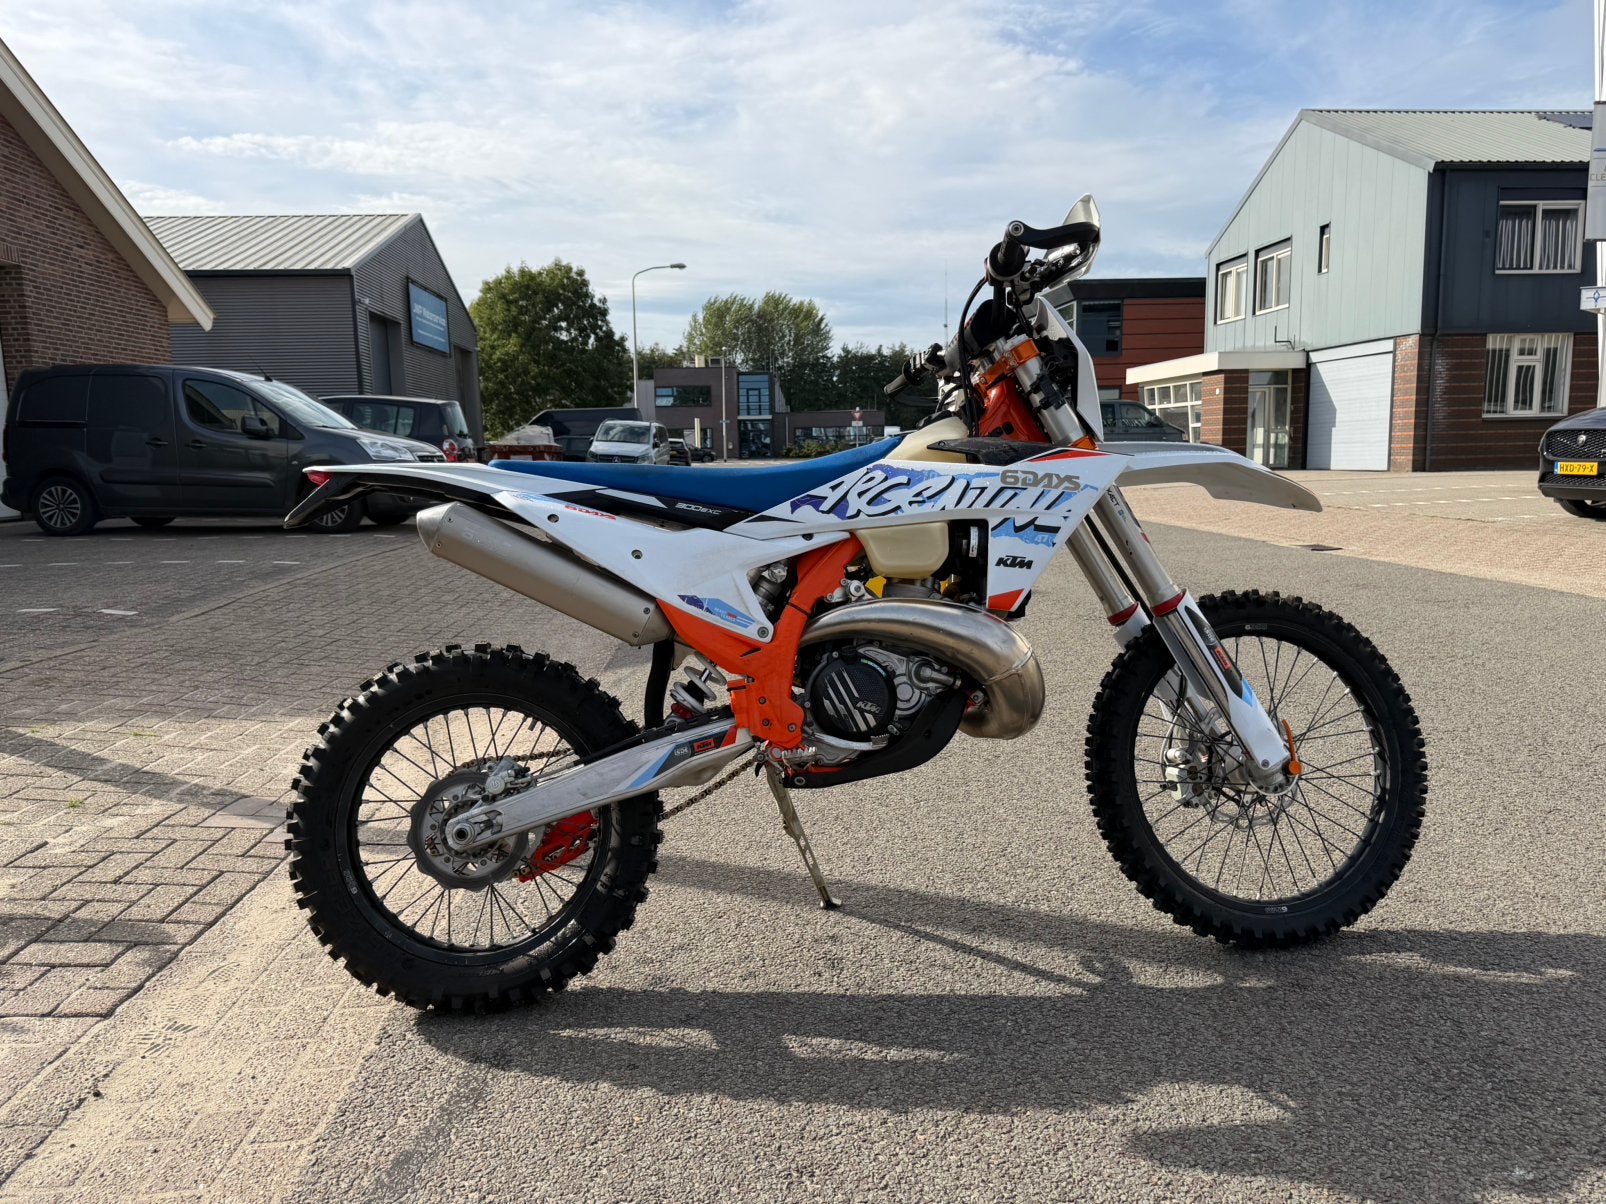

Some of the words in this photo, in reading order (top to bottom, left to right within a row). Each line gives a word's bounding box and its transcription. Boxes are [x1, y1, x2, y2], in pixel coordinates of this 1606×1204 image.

[1559, 463, 1595, 473] HXD-79-X
[1000, 469, 1081, 491] 6DAYS
[994, 555, 1034, 570] KTM
[856, 700, 881, 714] KTM
